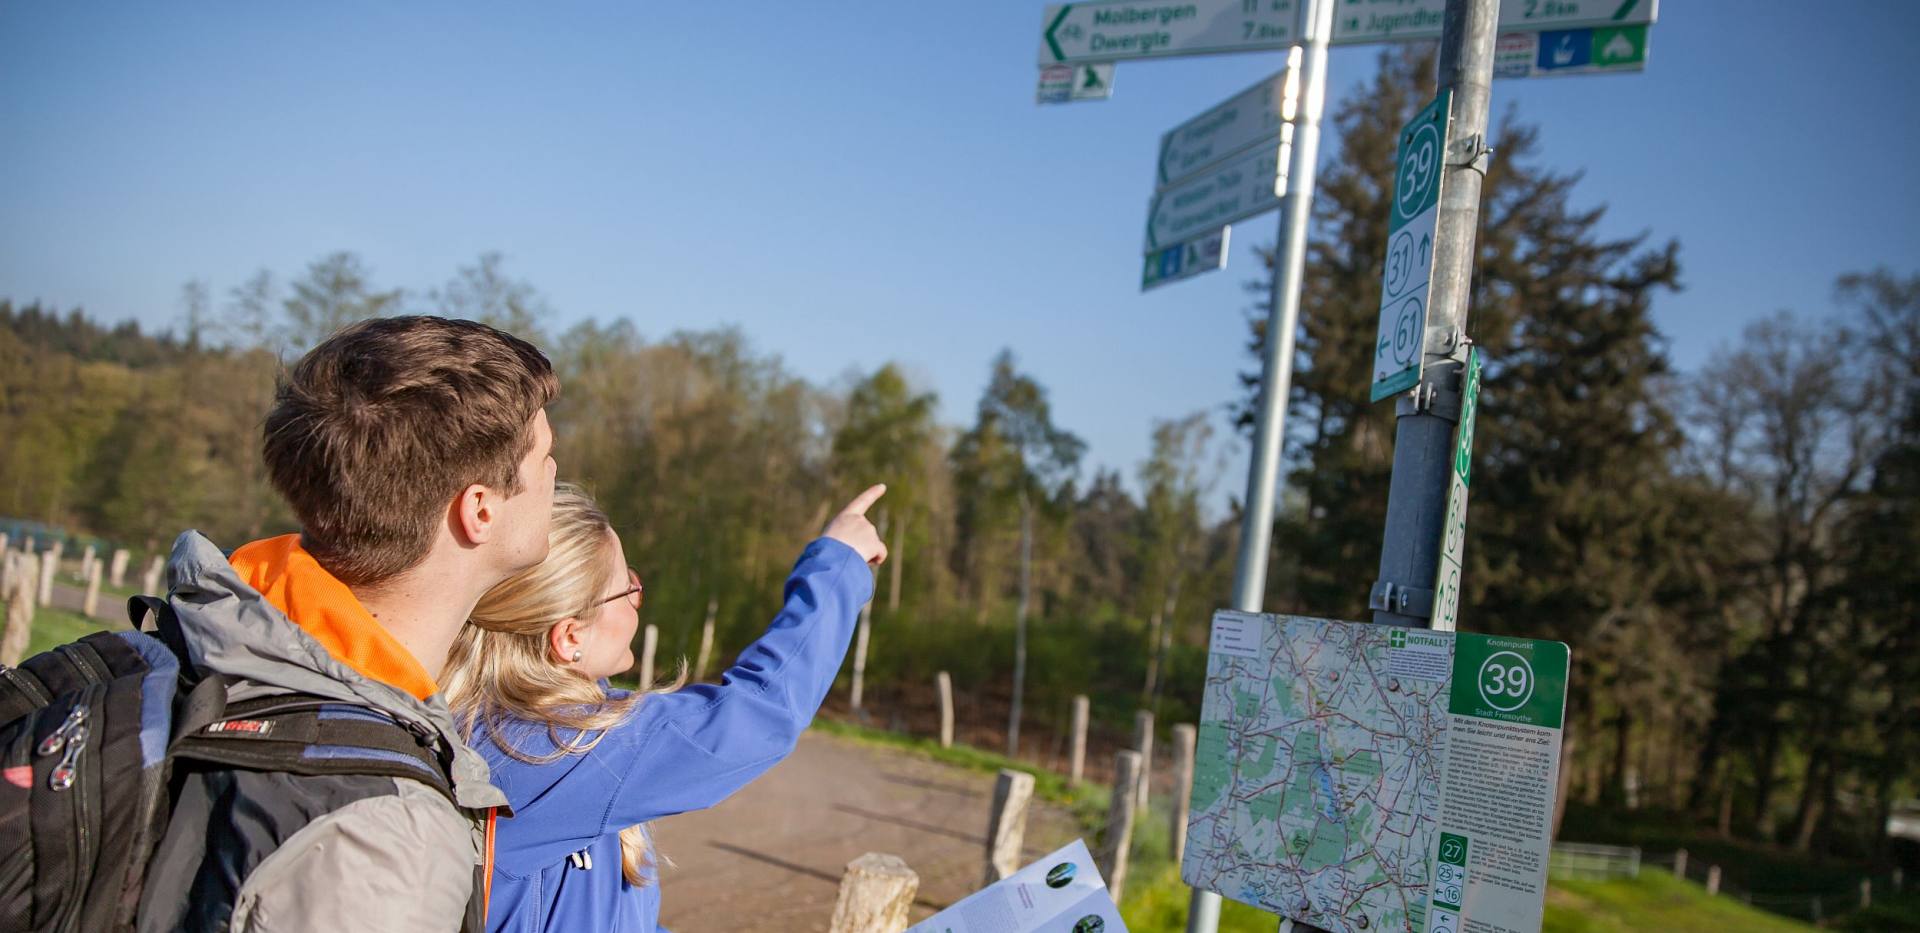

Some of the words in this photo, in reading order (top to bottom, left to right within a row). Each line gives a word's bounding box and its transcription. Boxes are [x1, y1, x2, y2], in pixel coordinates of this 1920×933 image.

[1092, 5, 1197, 26] Molbergen
[1367, 8, 1446, 36] Jugendhe
[1089, 31, 1171, 53] Dwergte
[1402, 141, 1432, 203] 39
[1389, 246, 1409, 279] 31
[1398, 310, 1417, 343] 61
[1407, 635, 1448, 648] NOTFALL?
[1487, 639, 1534, 650] Knotenpunkt
[1485, 663, 1527, 698] 39
[1475, 708, 1493, 717] Stadt
[1494, 732, 1506, 740] und
[1444, 843, 1461, 858] 27
[1440, 867, 1452, 878] 25
[1448, 889, 1457, 900] 16
